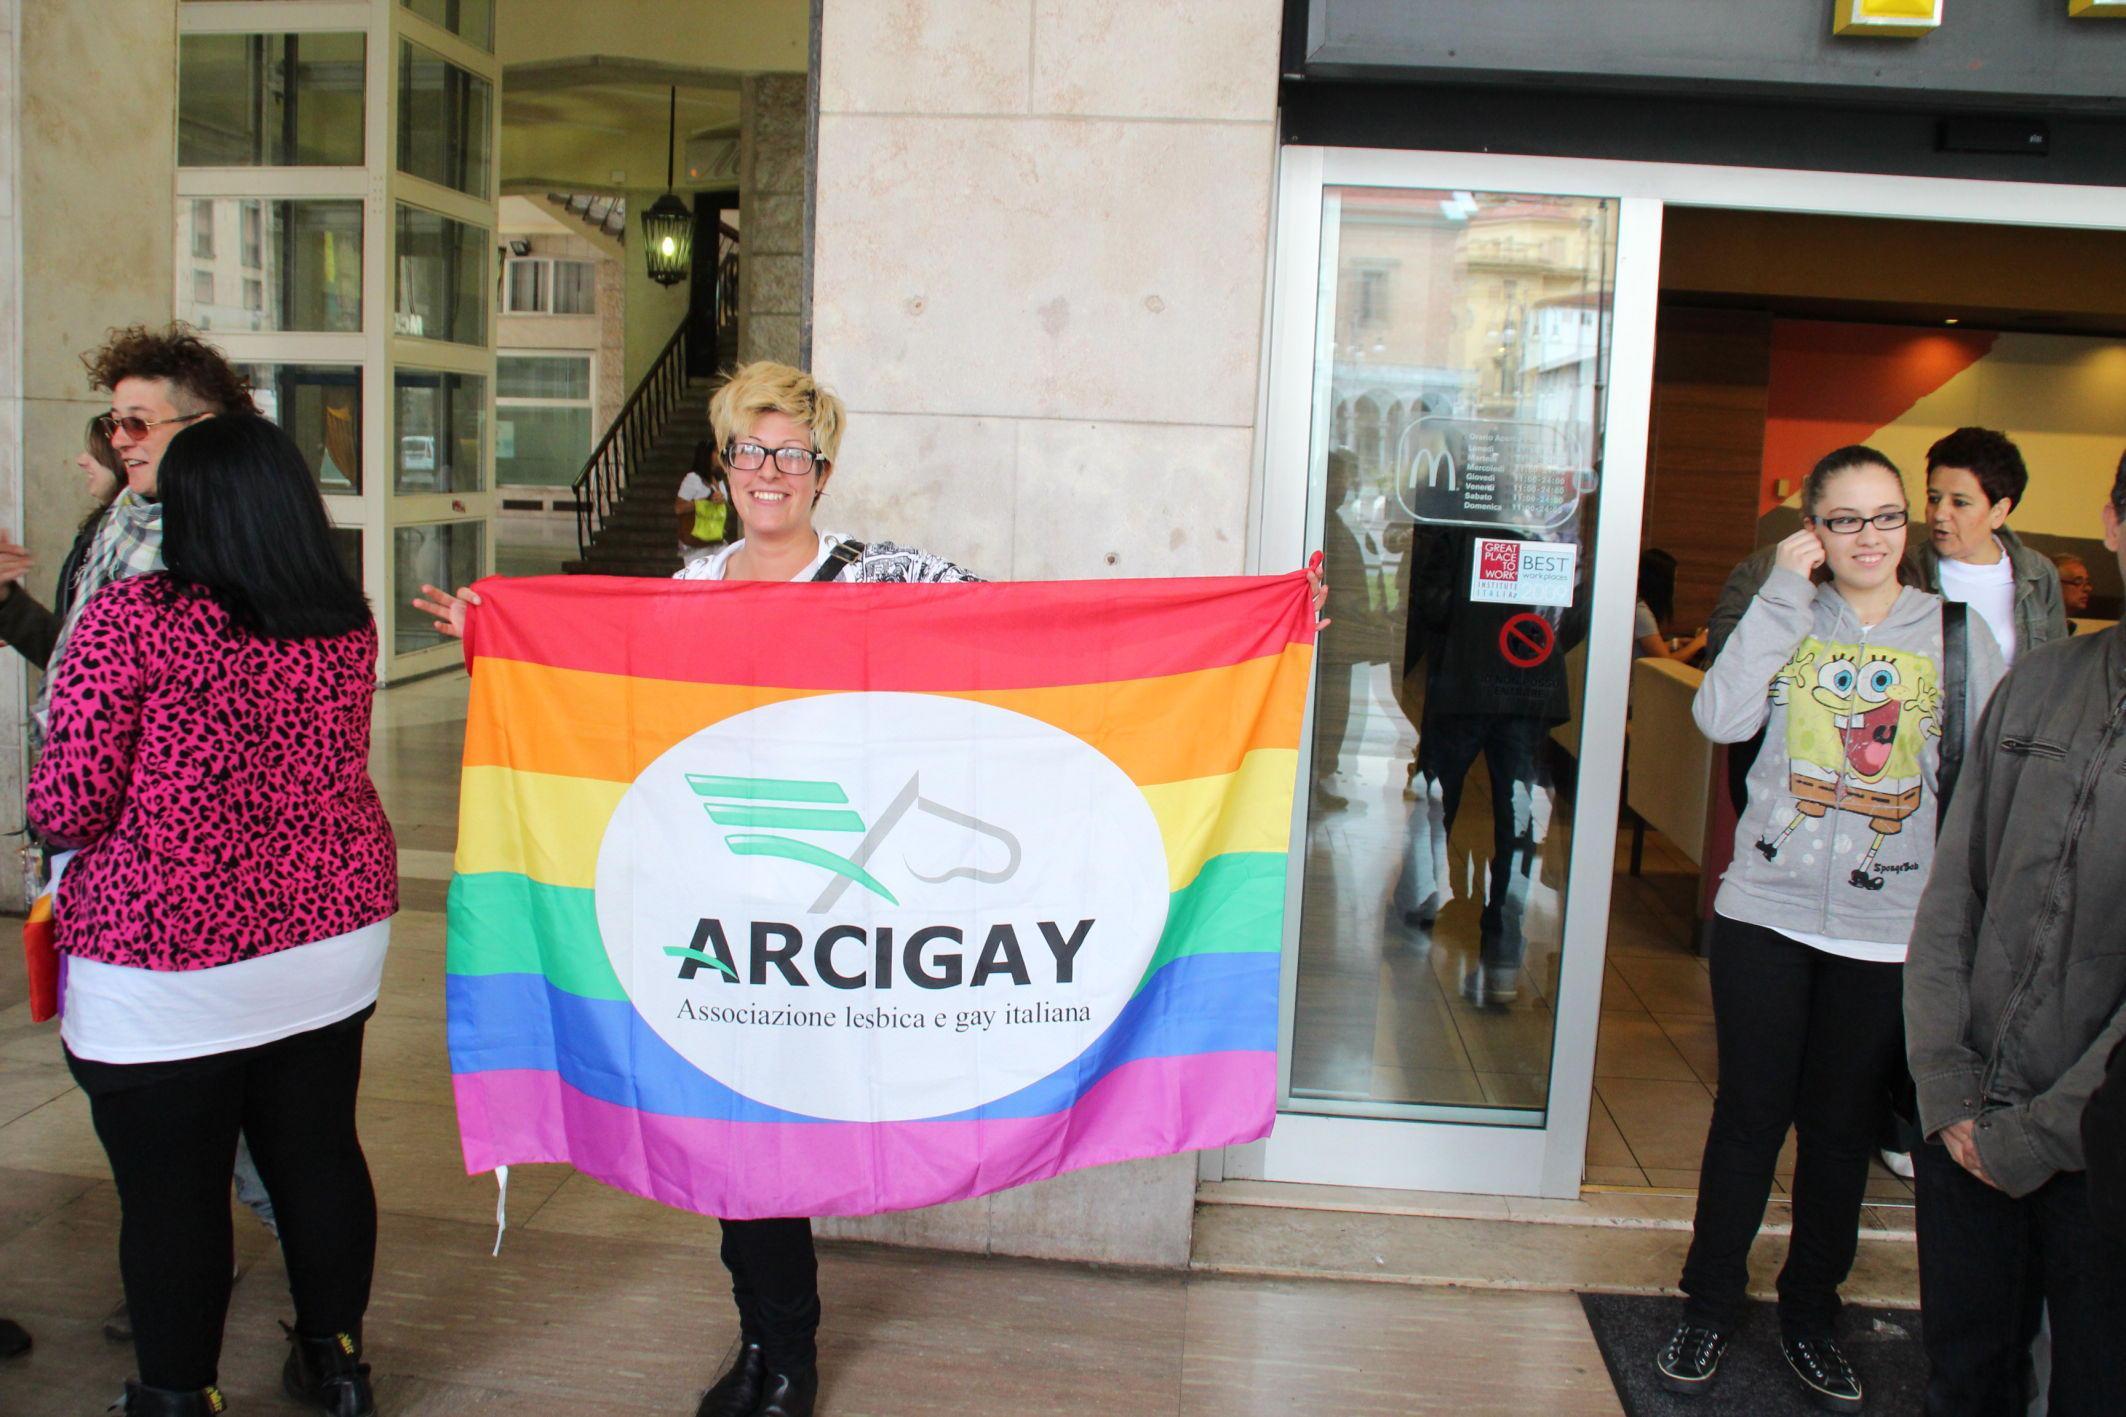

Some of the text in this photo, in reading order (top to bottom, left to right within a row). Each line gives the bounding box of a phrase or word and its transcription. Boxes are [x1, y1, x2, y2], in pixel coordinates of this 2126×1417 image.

[1464, 491, 1493, 501] Sabato
[1463, 501, 1503, 512] Domenica
[1484, 542, 1518, 553] GREAT
[1484, 552, 1517, 562] PLACE
[1502, 561, 1516, 571] TO
[1522, 555, 1570, 573] BEST
[1522, 573, 1569, 581] workplaces
[1873, 861, 1919, 875] SpongeBob
[676, 917, 1097, 990] ARCIGAY
[675, 997, 1092, 1033] Associazione lesbica e gay italiana
